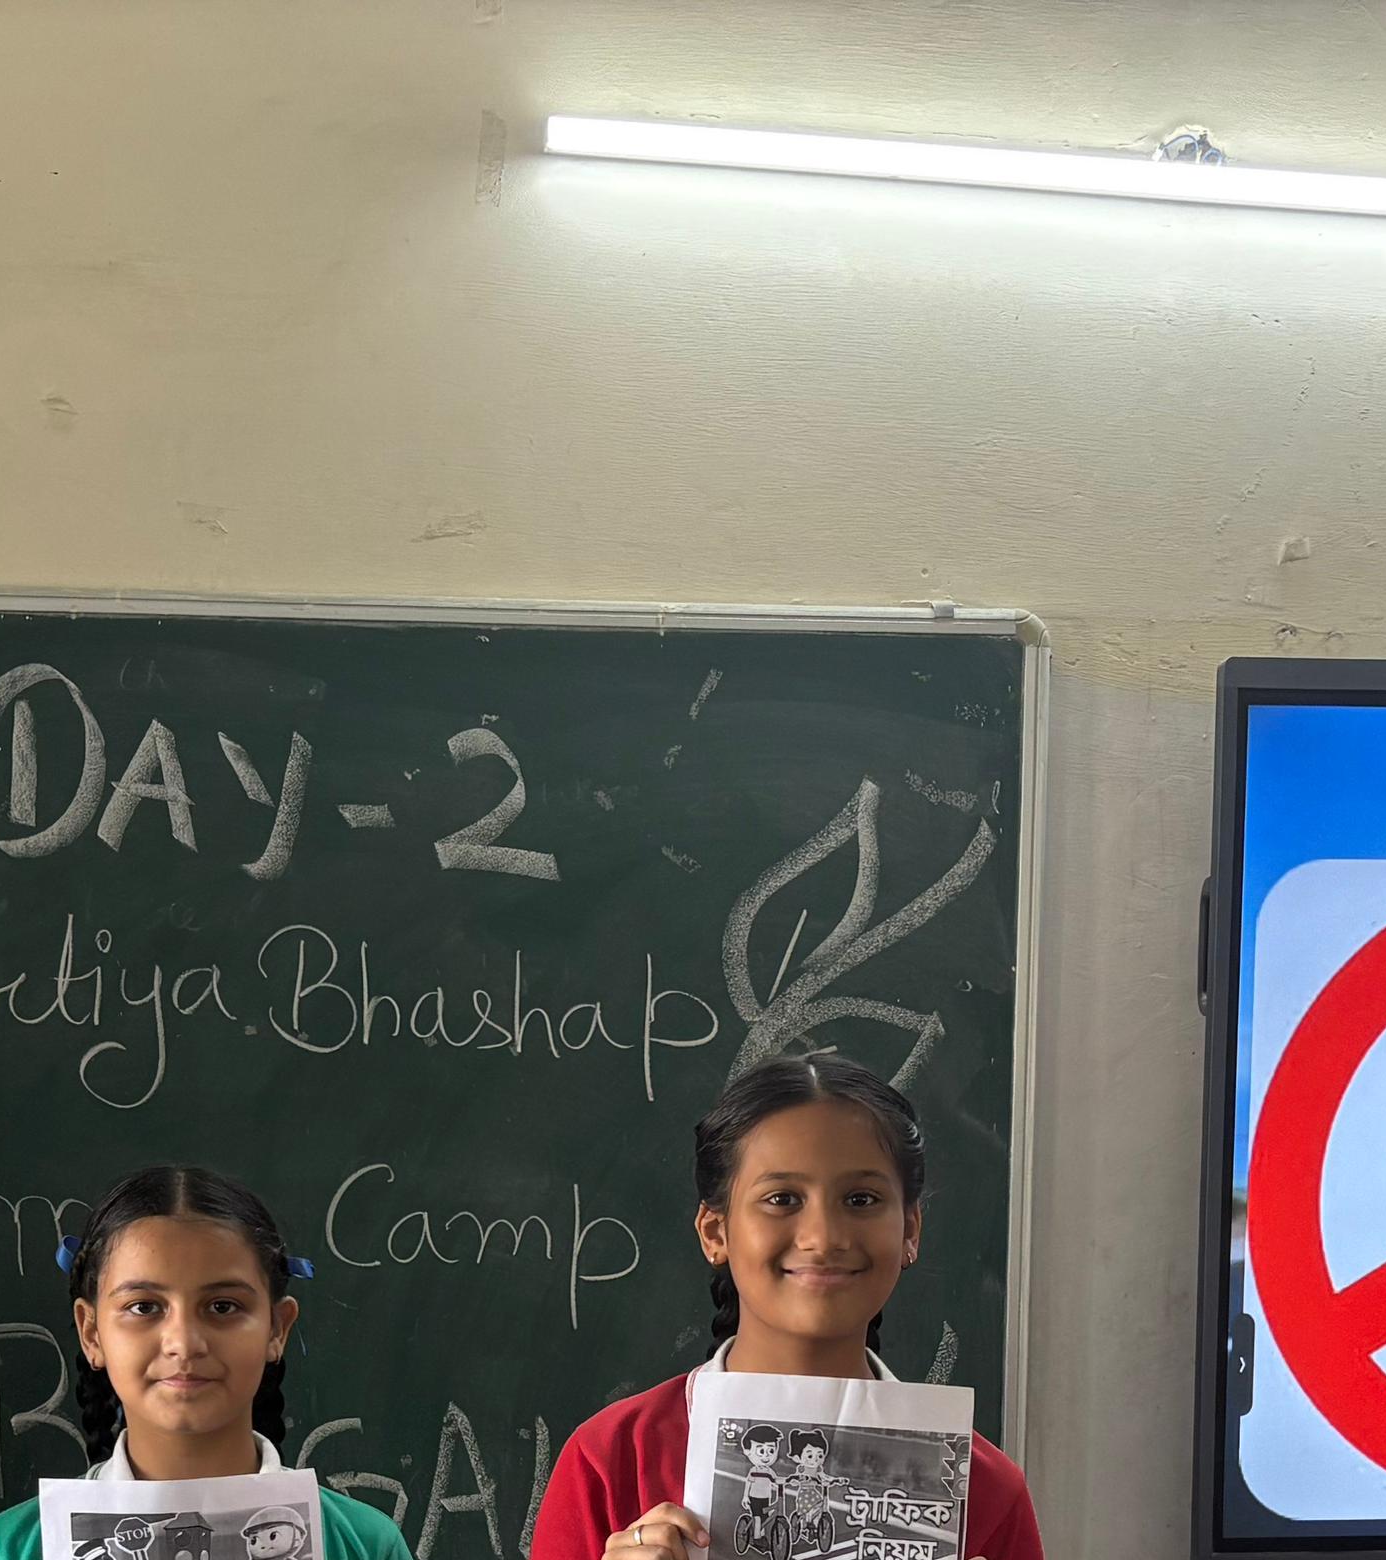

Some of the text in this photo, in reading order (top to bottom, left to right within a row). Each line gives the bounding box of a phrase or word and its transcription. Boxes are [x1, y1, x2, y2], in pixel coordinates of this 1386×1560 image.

[324, 1162, 640, 1331] Camp
[844, 1485, 955, 1528] ট্রাফিক
[116, 1527, 151, 1543] STOP
